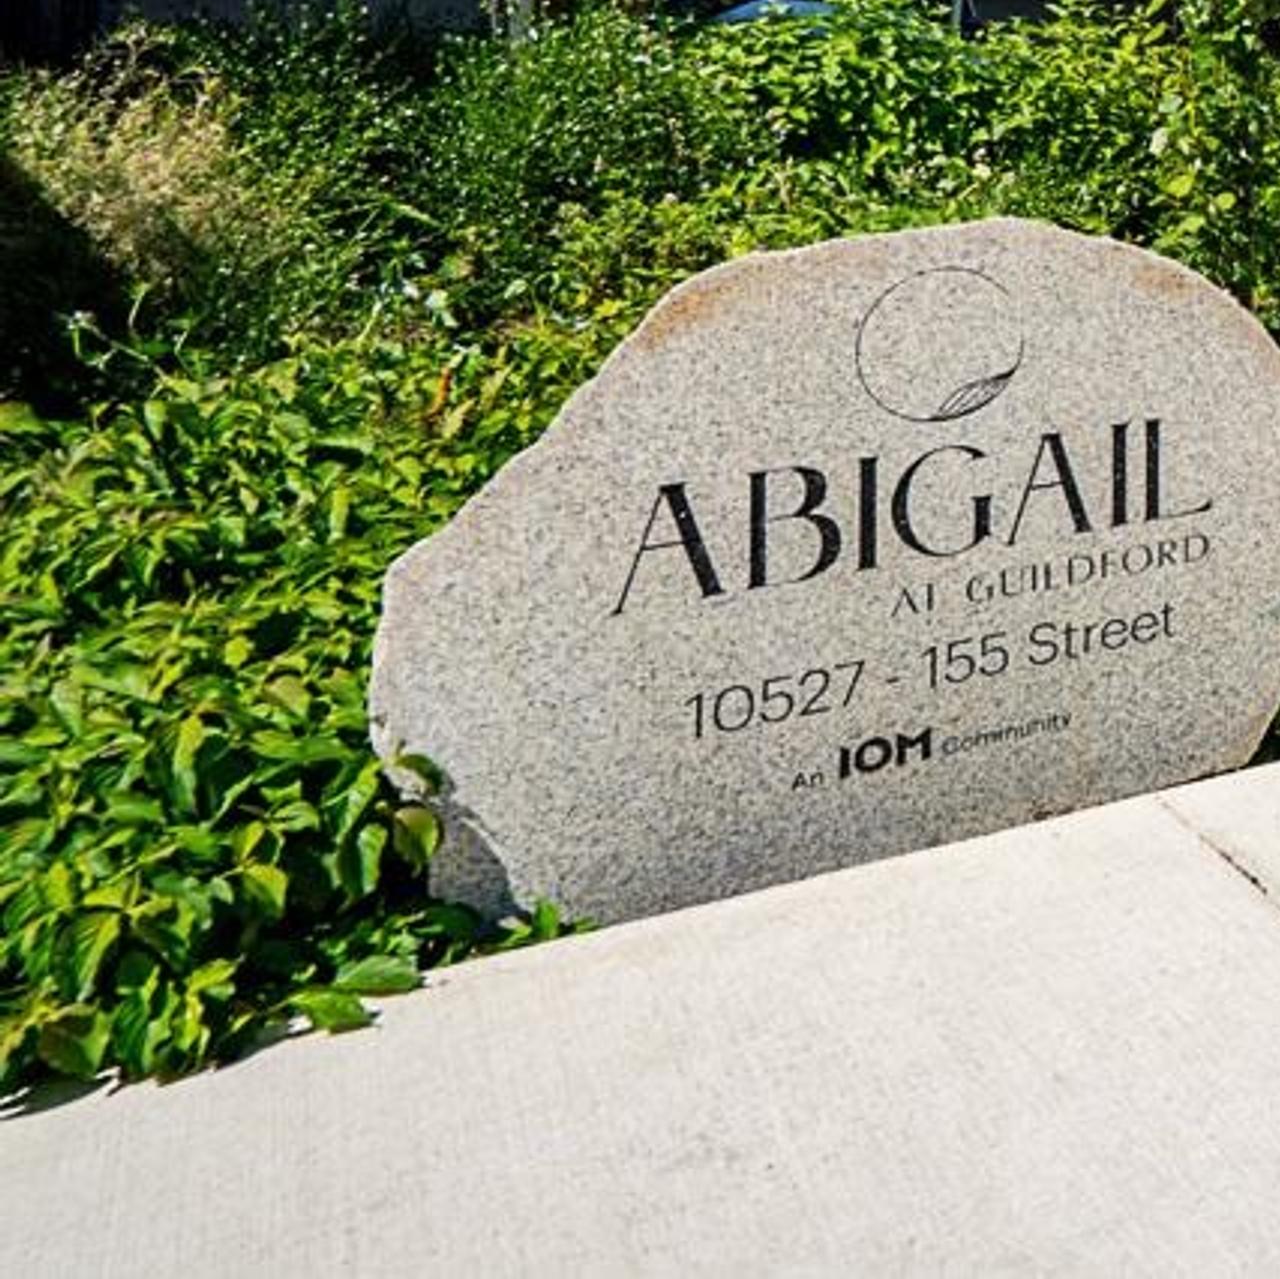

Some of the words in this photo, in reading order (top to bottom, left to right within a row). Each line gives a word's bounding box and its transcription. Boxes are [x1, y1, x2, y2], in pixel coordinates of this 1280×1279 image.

[612, 418, 1213, 616] ABIGAIL
[965, 533, 1211, 603] GUILDFORD
[686, 660, 866, 739] 10527
[923, 631, 1010, 690] 155
[1028, 602, 1175, 667] Street
[791, 770, 825, 791] An
[838, 726, 933, 780] IOM
